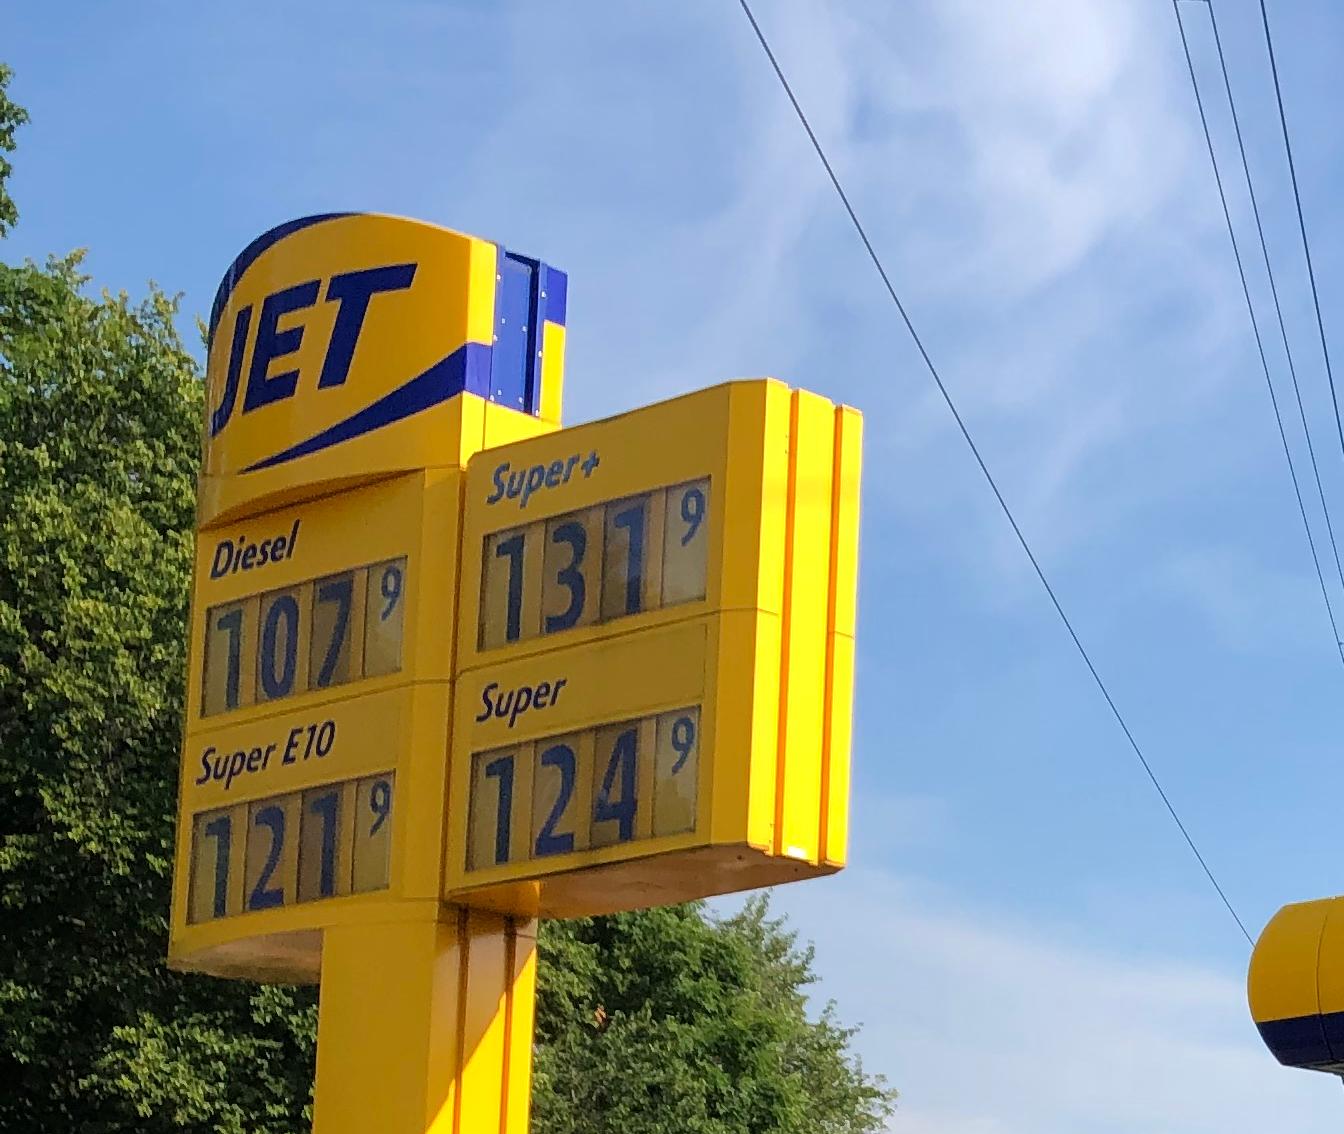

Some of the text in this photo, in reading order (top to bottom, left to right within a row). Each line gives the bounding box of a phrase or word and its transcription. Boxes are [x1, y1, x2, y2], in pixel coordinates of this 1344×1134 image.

[210, 263, 418, 437] JET
[486, 451, 601, 507] Super+
[209, 520, 301, 581] Diesel
[475, 676, 567, 729] Super
[195, 720, 337, 790] Super E10
